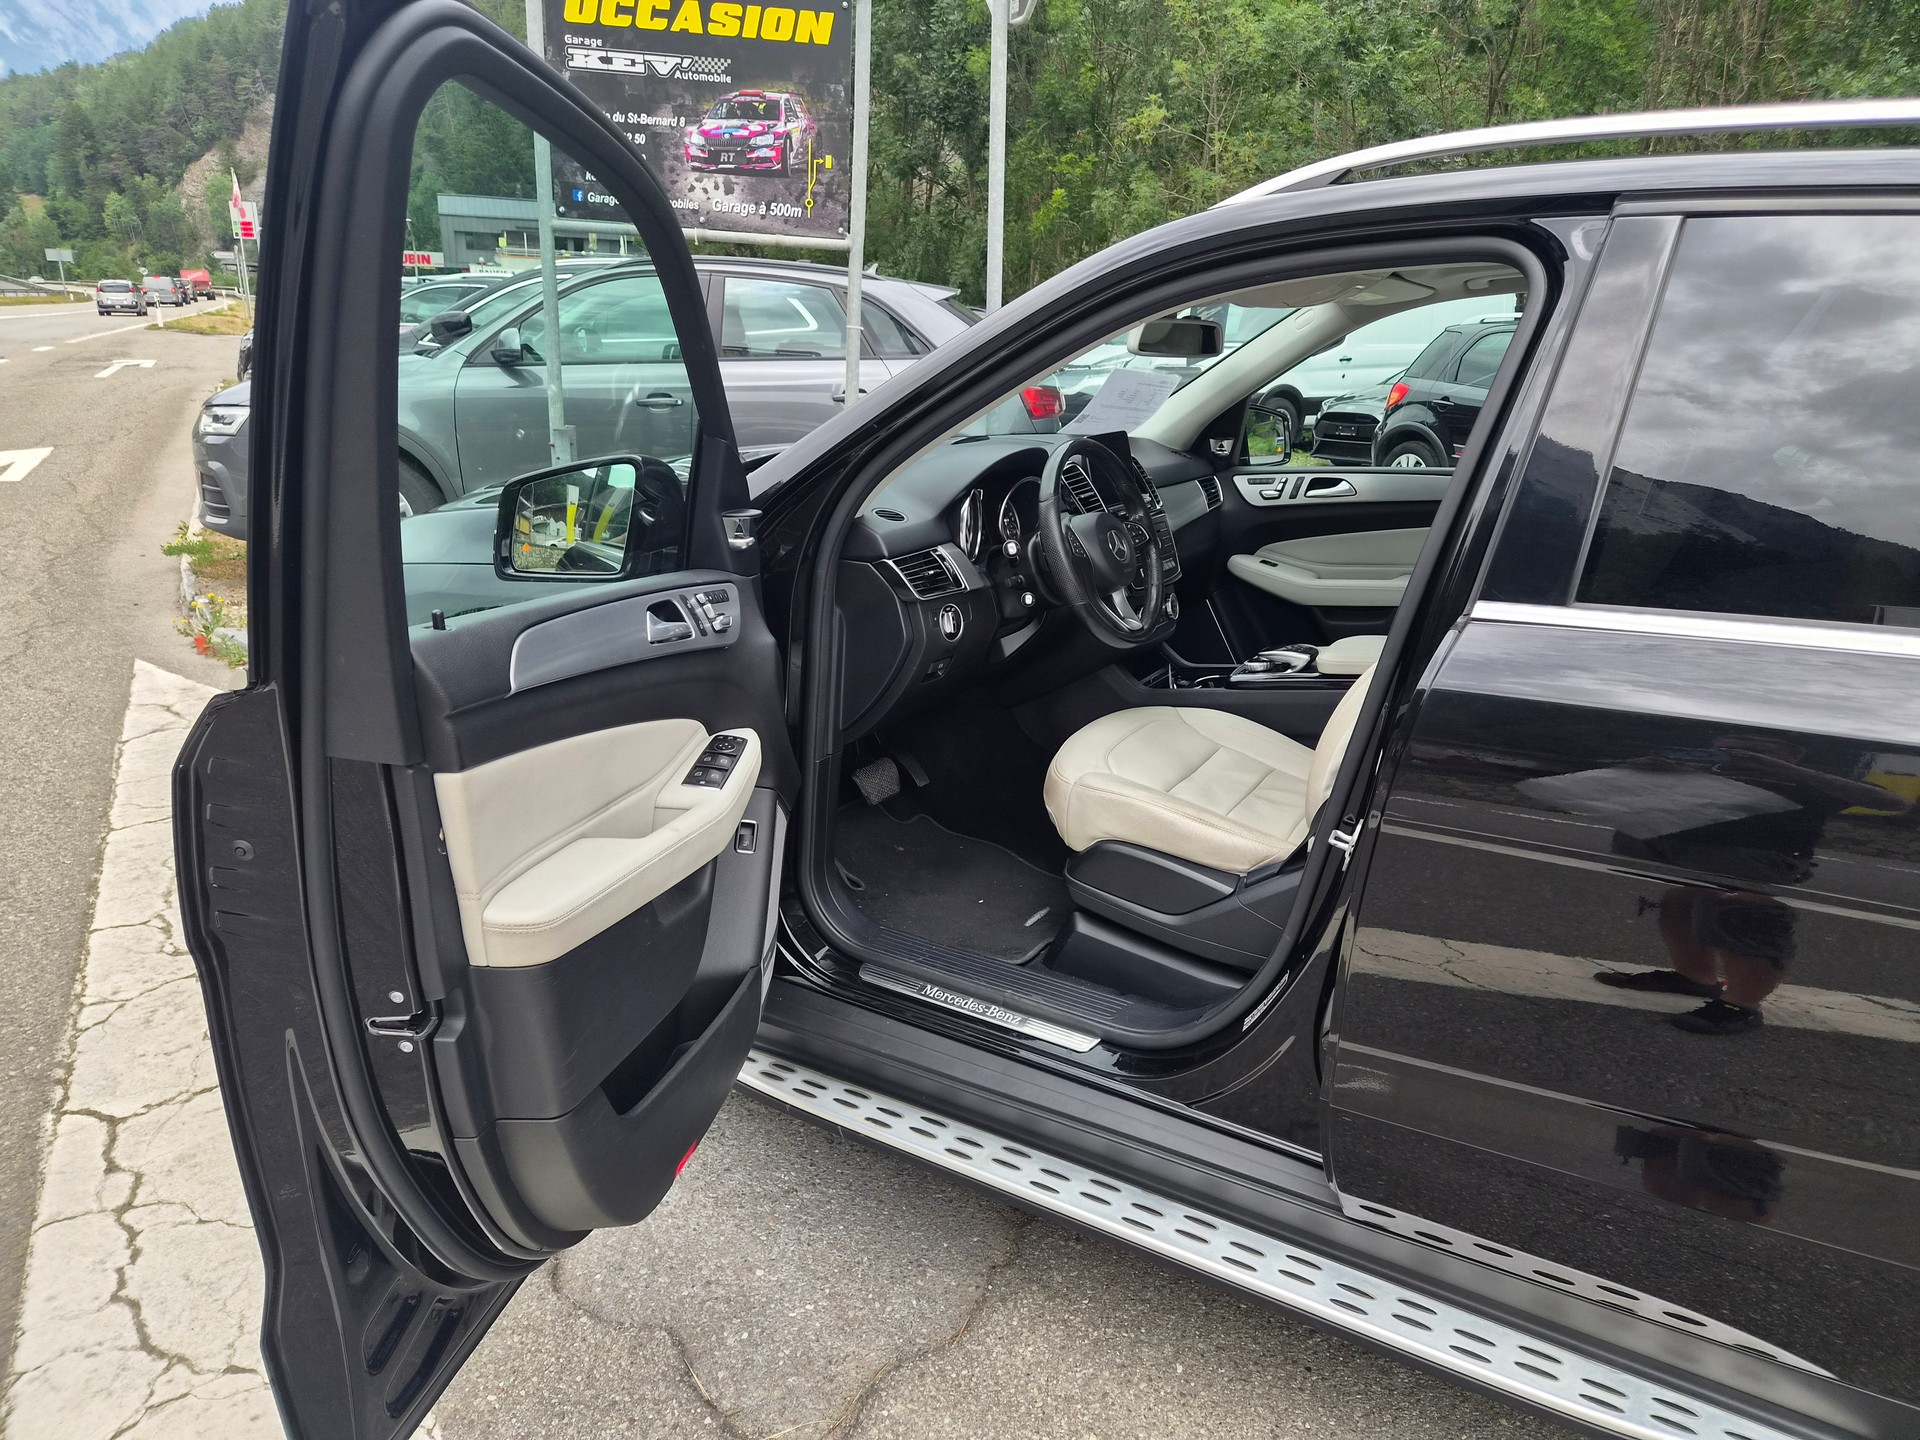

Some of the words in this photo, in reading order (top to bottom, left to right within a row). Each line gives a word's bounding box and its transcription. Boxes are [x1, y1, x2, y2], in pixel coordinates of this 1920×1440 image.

[563, 0, 835, 45] OCCASION
[564, 34, 603, 47] Garage
[674, 70, 732, 84] Automobile
[613, 111, 625, 123] du
[627, 112, 678, 128] St-Bernard
[679, 116, 686, 128] 8
[634, 133, 646, 145] 50
[720, 151, 736, 163] RT
[669, 199, 699, 210] obiles
[712, 199, 756, 217] Garage
[758, 201, 767, 215] à
[769, 202, 803, 218] 500m
[921, 984, 1023, 1025] Mercedes-Benz
